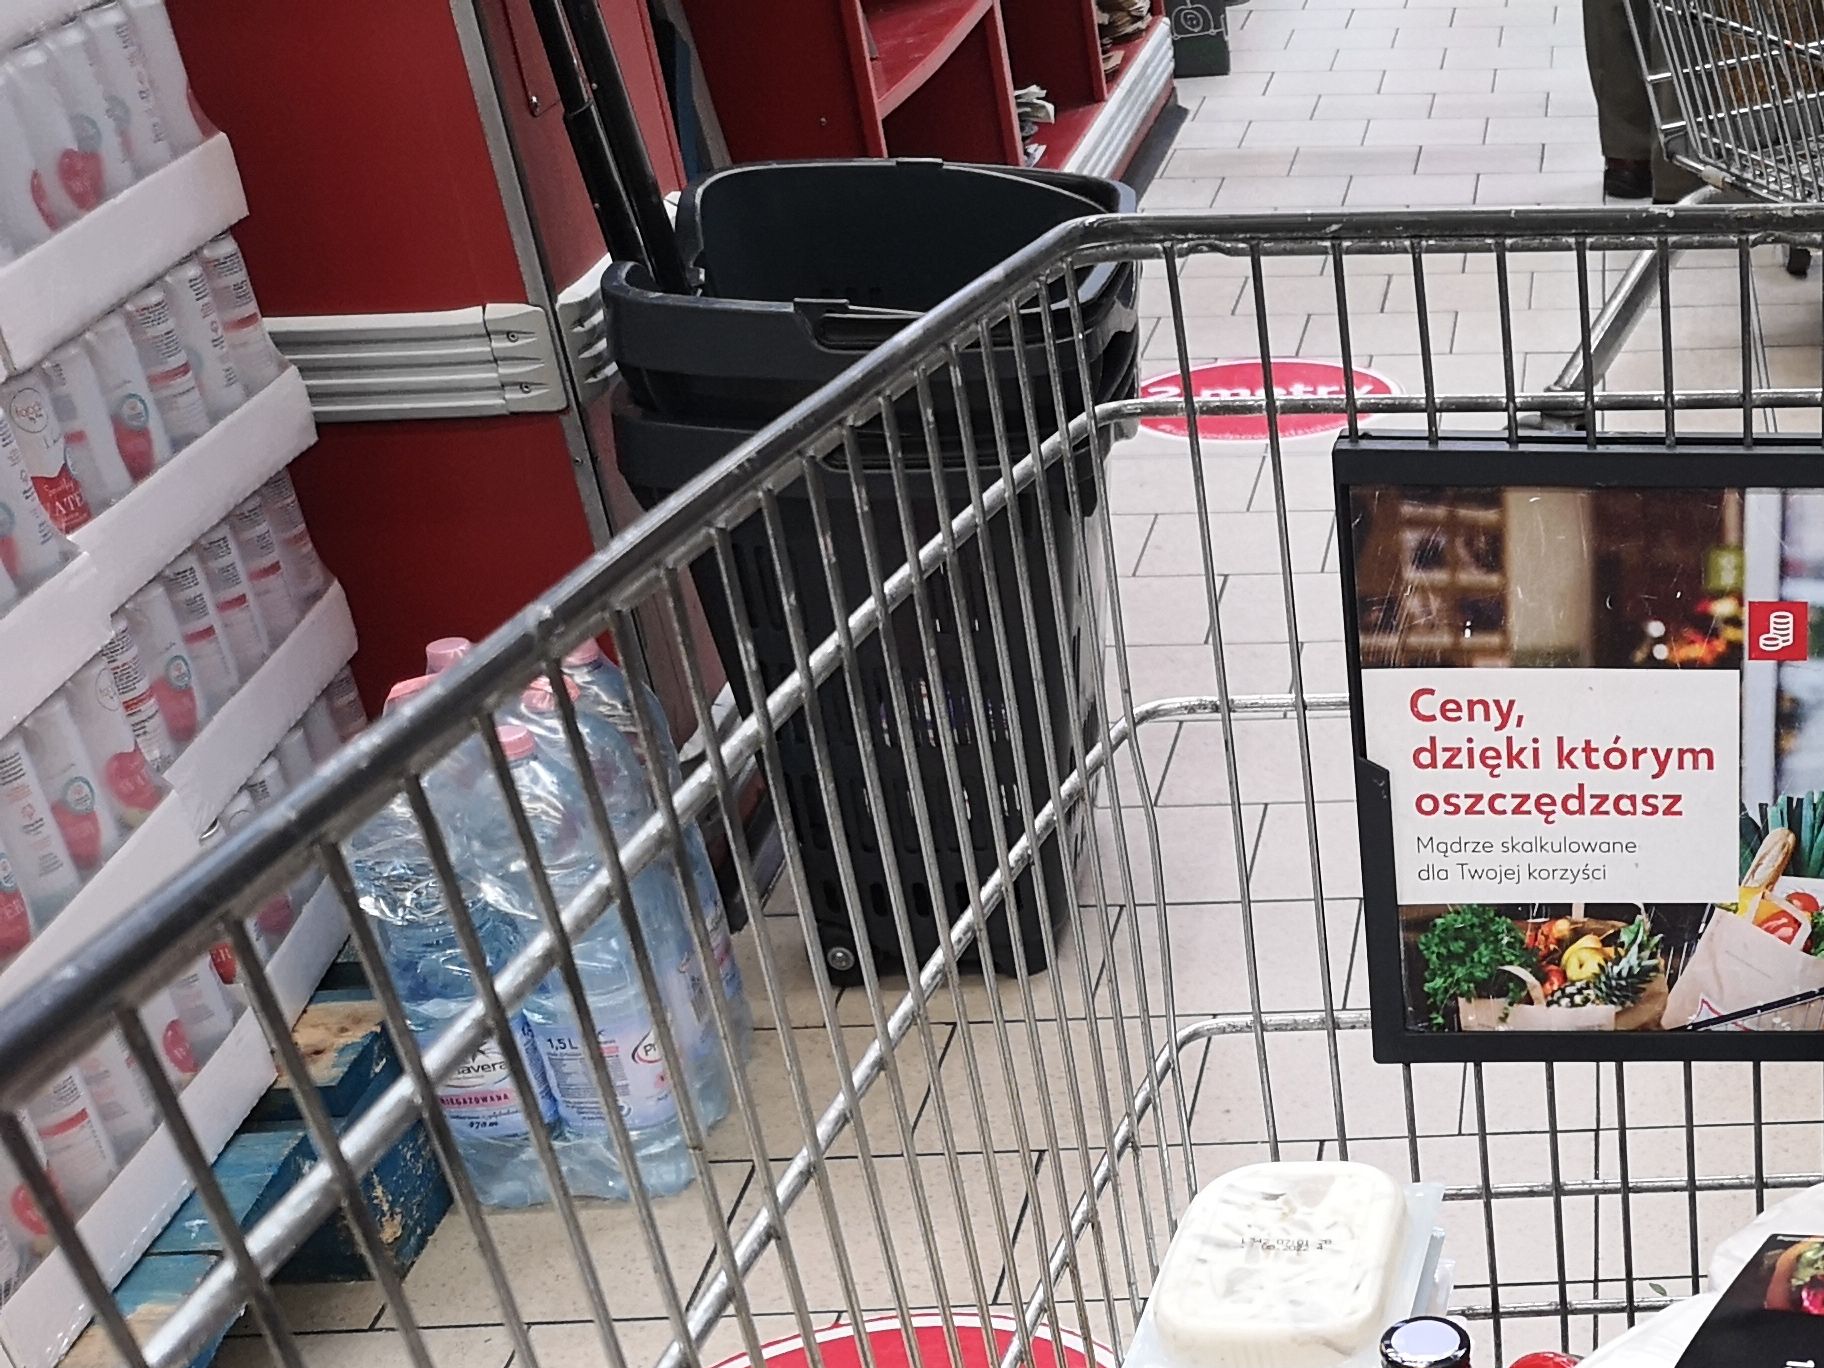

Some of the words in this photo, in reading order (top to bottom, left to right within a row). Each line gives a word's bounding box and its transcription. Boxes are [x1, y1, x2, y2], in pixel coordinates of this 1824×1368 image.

[1409, 687, 1525, 732] Ceny,
[1412, 736, 1540, 778] dzięki
[1556, 735, 1715, 779] którym
[1414, 782, 1684, 825] oszczędzasz
[1416, 836, 1494, 858] Mądrze
[1500, 835, 1637, 855] skalkulowane
[1417, 863, 1449, 881] dla
[1456, 863, 1520, 884] Twojej
[1528, 861, 1607, 885] korzyści
